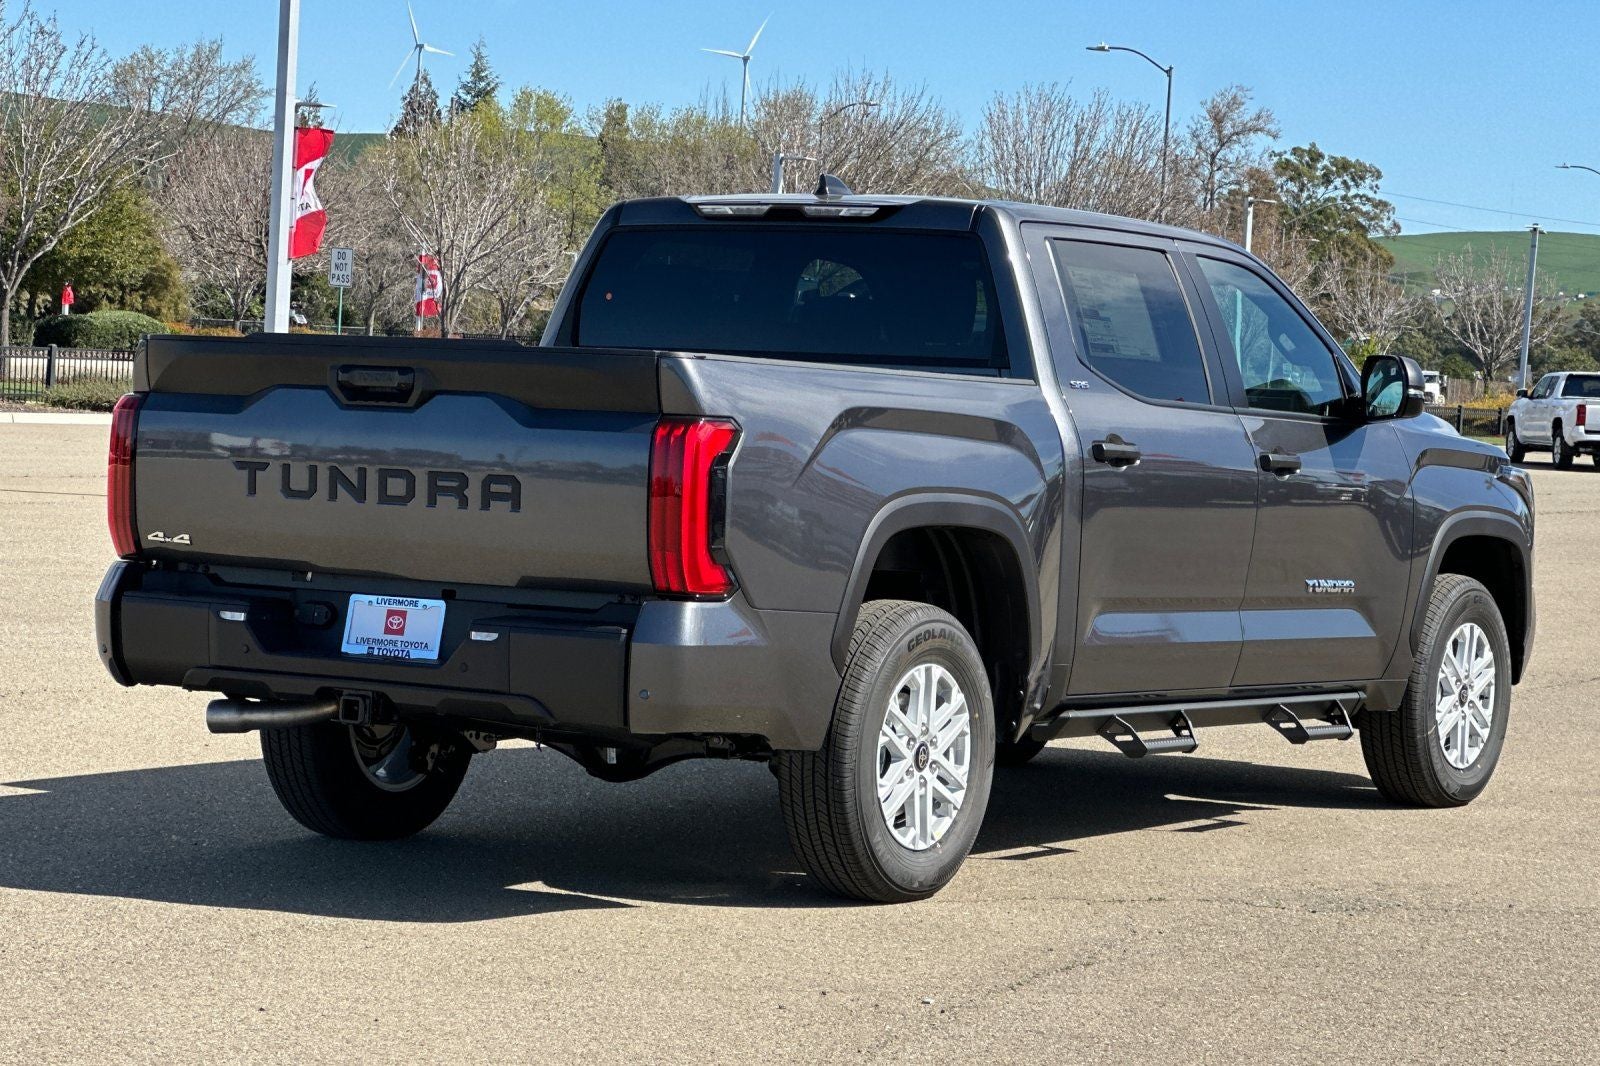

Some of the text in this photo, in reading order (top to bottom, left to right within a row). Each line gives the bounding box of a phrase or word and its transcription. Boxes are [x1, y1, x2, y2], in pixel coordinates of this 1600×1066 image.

[337, 251, 346, 261] DO
[334, 262, 348, 272] NOT
[331, 273, 350, 284] PASS
[233, 460, 522, 513] TUNDRA
[1305, 579, 1355, 593] TUNDRA
[376, 597, 419, 608] LIVERMORE
[355, 636, 429, 650] LIVERMORE TOYOTA
[377, 647, 411, 659] TOYOTA
